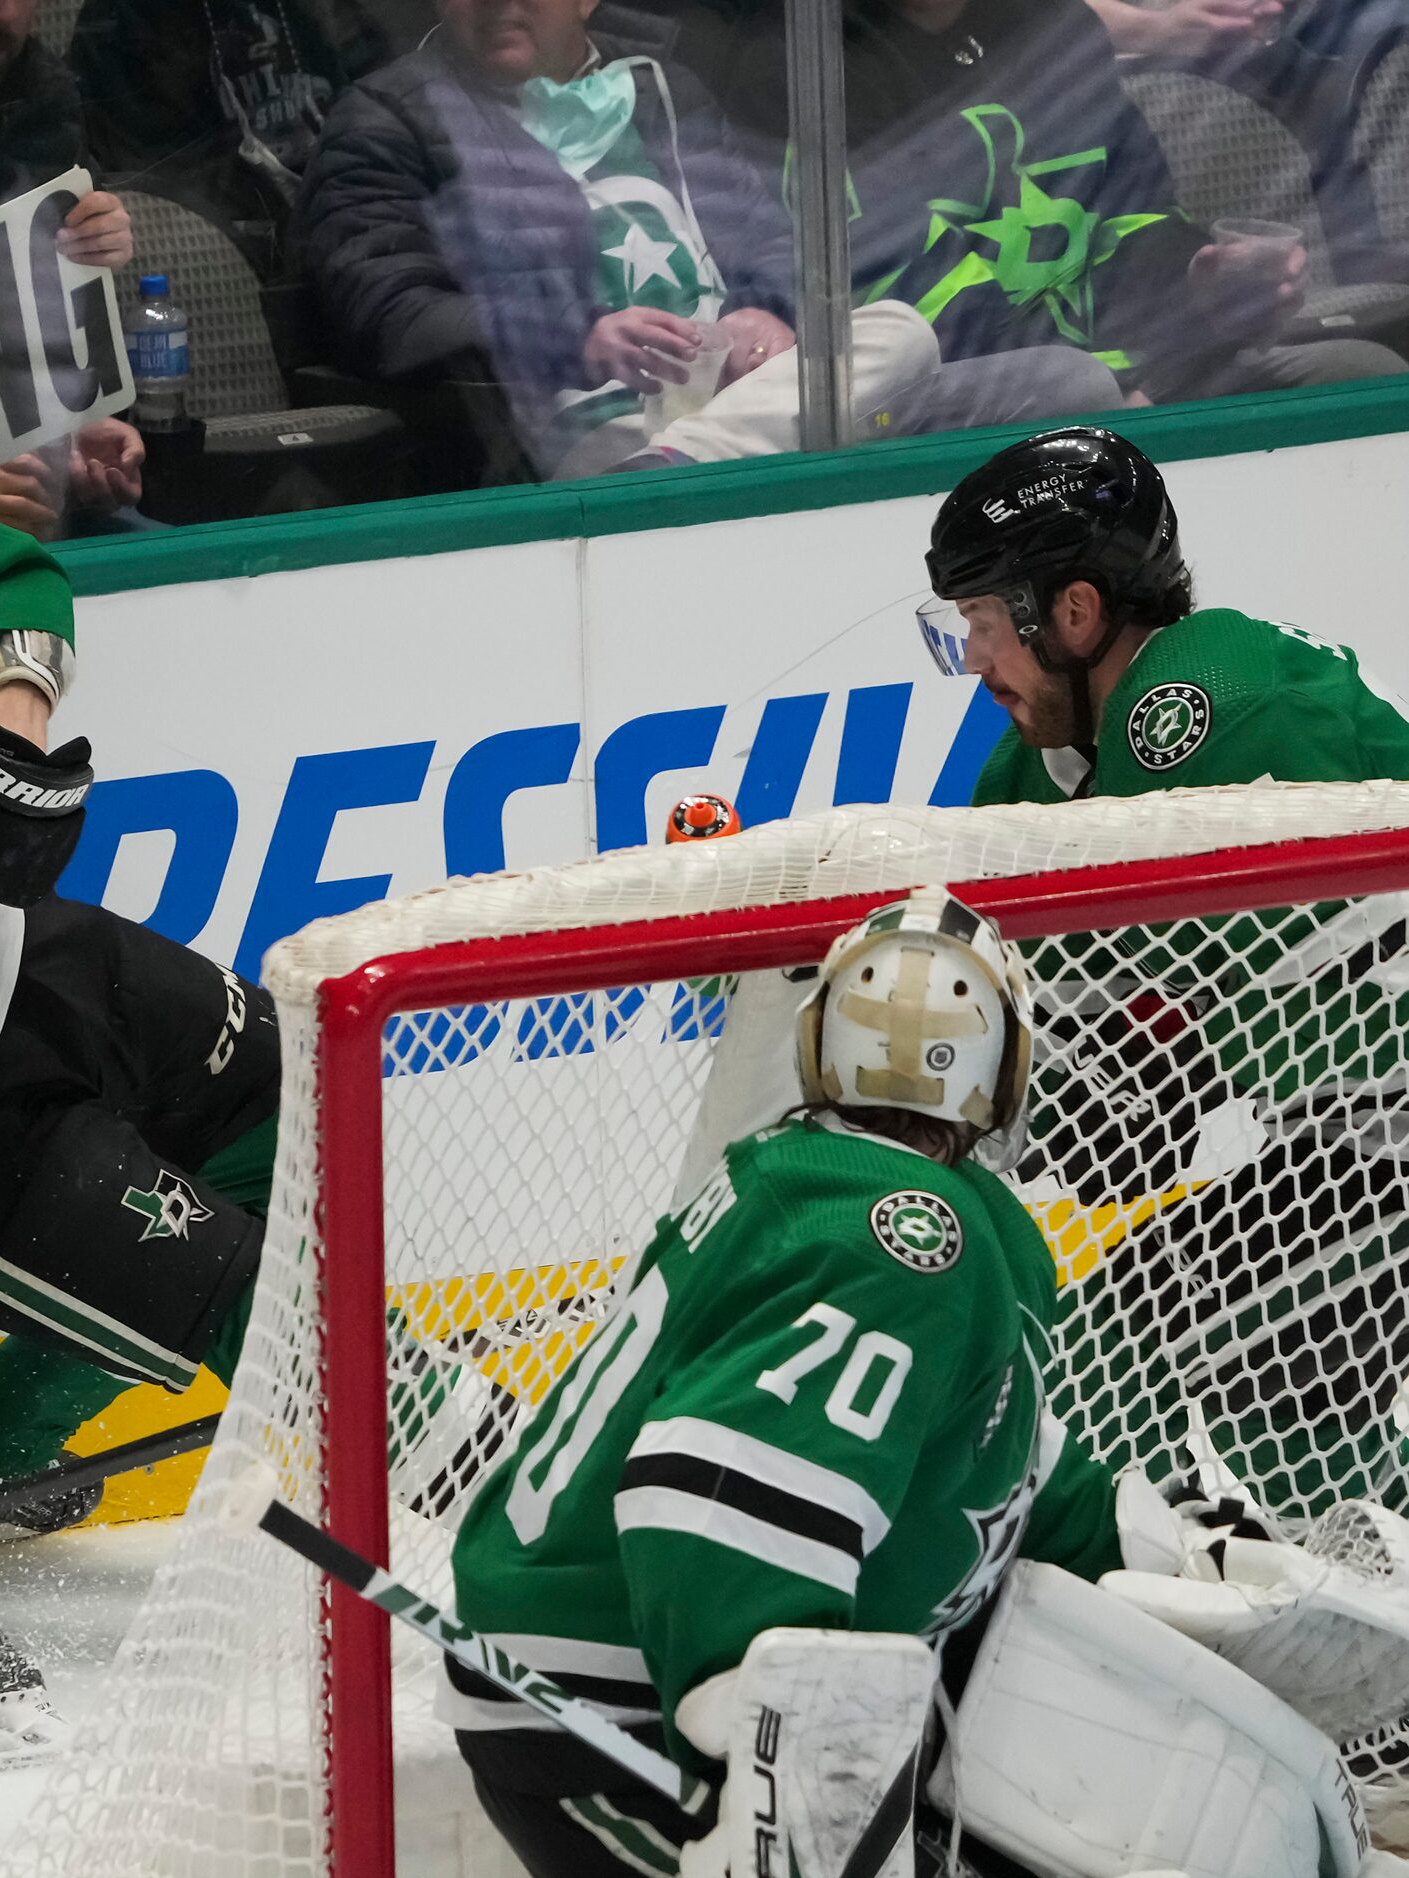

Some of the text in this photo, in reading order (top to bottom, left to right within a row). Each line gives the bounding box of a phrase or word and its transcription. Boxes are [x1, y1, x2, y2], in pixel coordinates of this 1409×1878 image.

[1017, 473, 1066, 499] ENERGY
[1020, 480, 1085, 509] TRANSFER
[1132, 688, 1193, 749] DALLAS
[1153, 709, 1205, 765] STARS
[755, 1302, 914, 1443] 70
